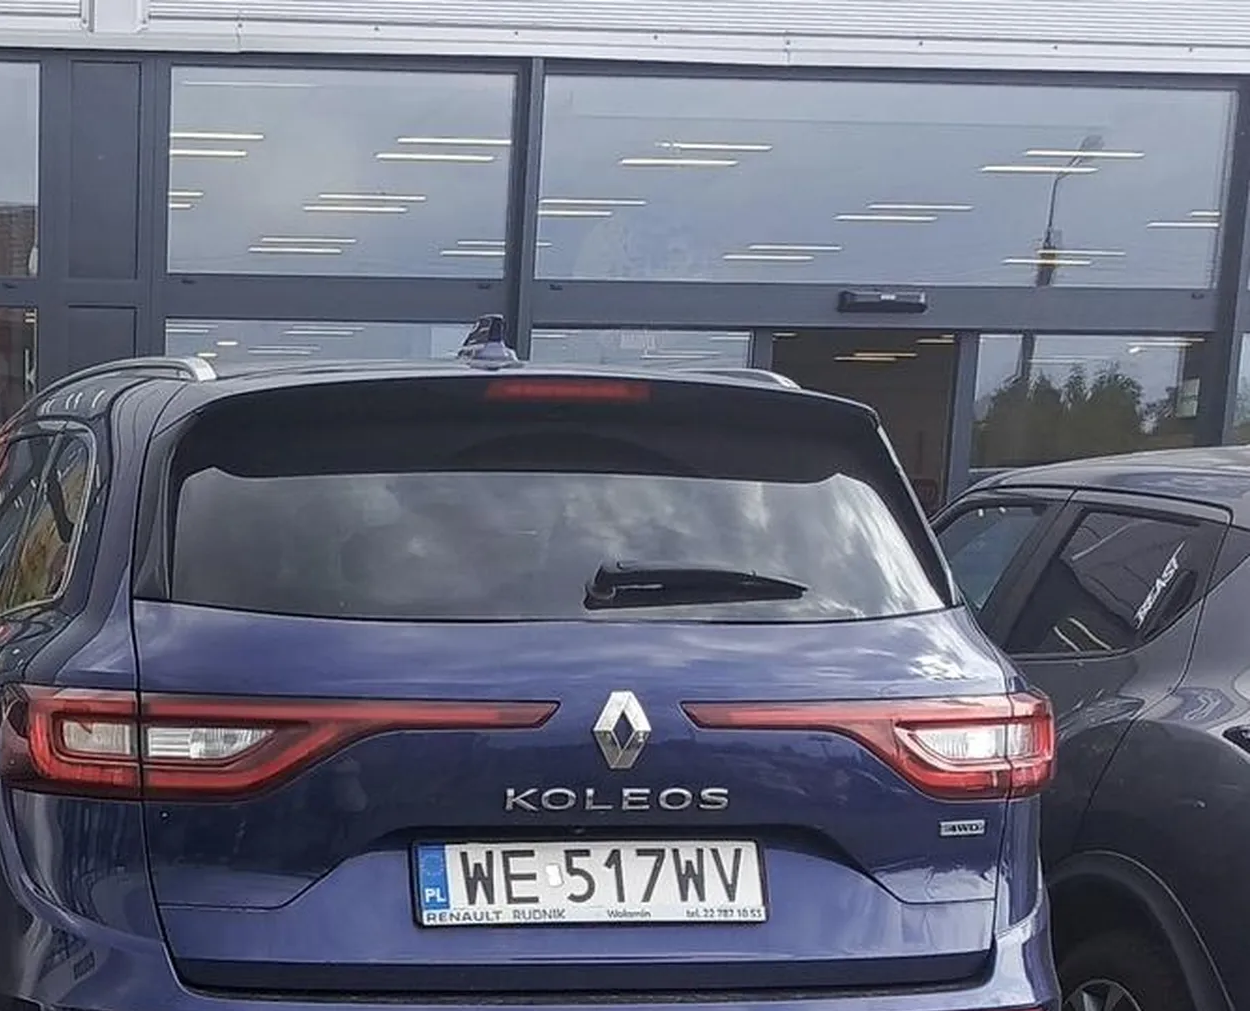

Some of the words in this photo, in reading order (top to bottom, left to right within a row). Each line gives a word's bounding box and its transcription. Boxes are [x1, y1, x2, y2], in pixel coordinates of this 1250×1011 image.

[505, 787, 729, 812] KOLEOS
[459, 849, 540, 905] WE
[562, 847, 743, 904] 517WV
[424, 887, 447, 903] PL
[425, 909, 502, 923] RENAULT
[512, 908, 566, 921] RUDNIK
